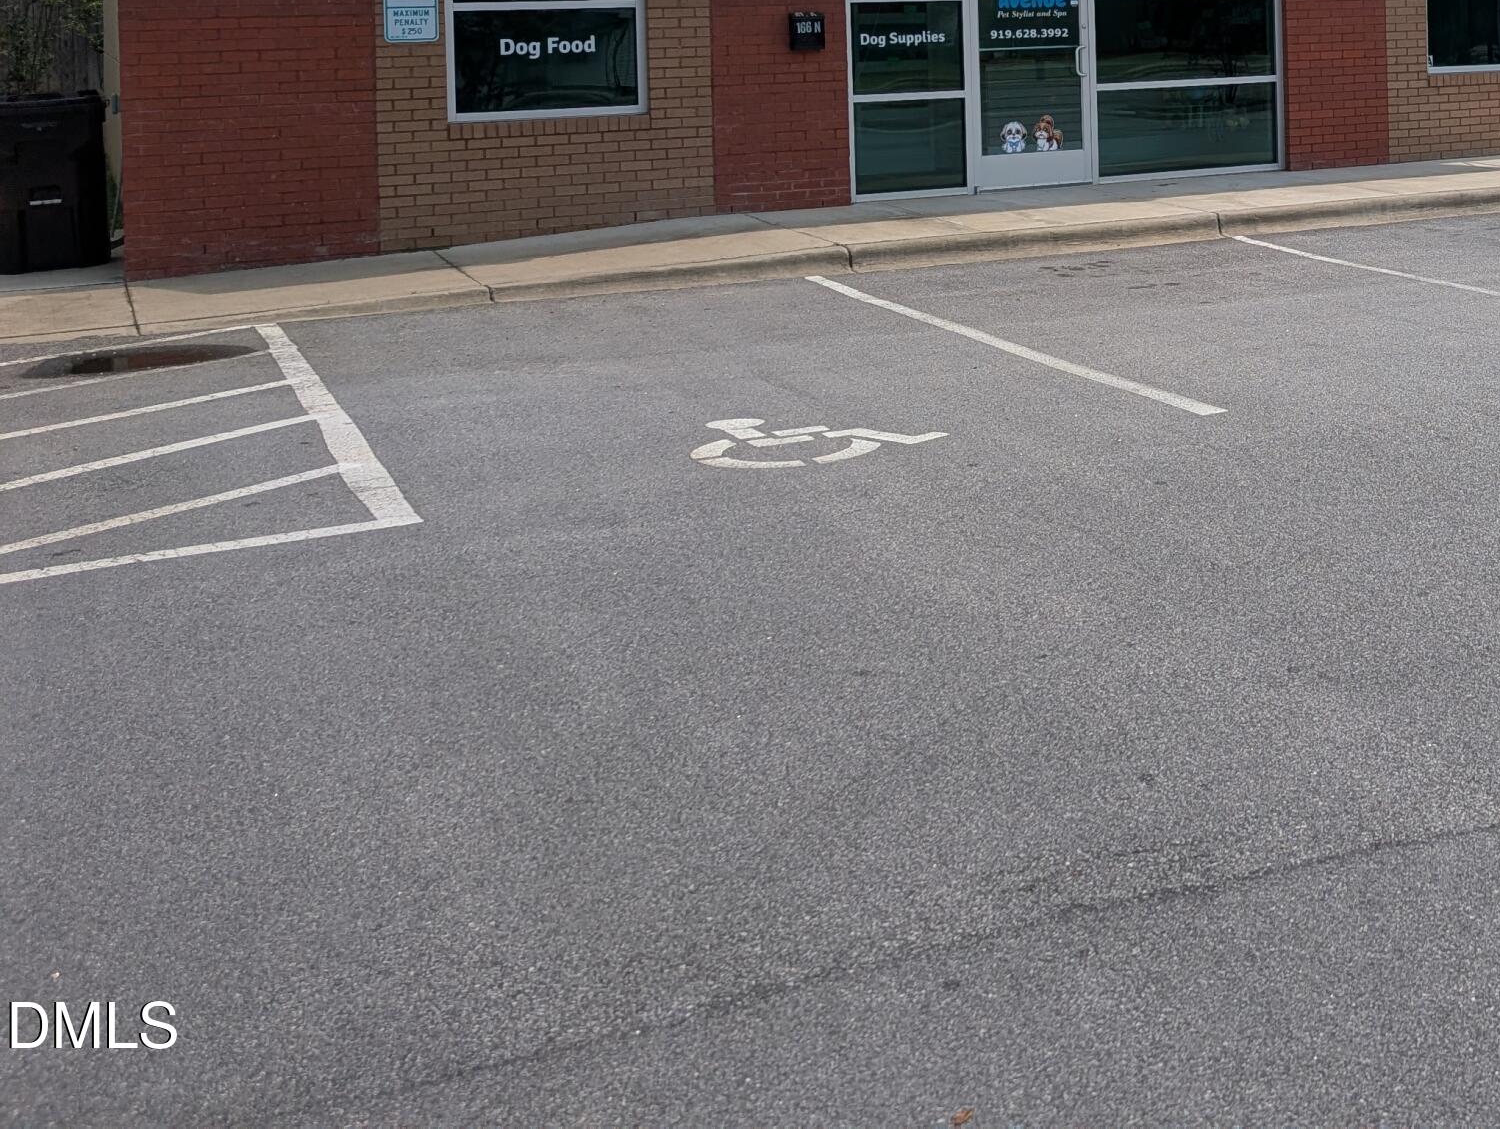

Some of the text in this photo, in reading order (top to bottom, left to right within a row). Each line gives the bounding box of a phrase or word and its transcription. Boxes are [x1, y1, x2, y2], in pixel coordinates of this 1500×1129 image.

[392, 9, 430, 17] MAXIMUM
[997, 8, 1067, 20] Pet Stylist and Spa
[394, 18, 429, 27] PENALTY
[796, 20, 822, 34] 166 N
[860, 31, 946, 47] Dog Supplies
[990, 28, 1069, 40] 919.628.3992
[499, 35, 596, 59] Dog Food
